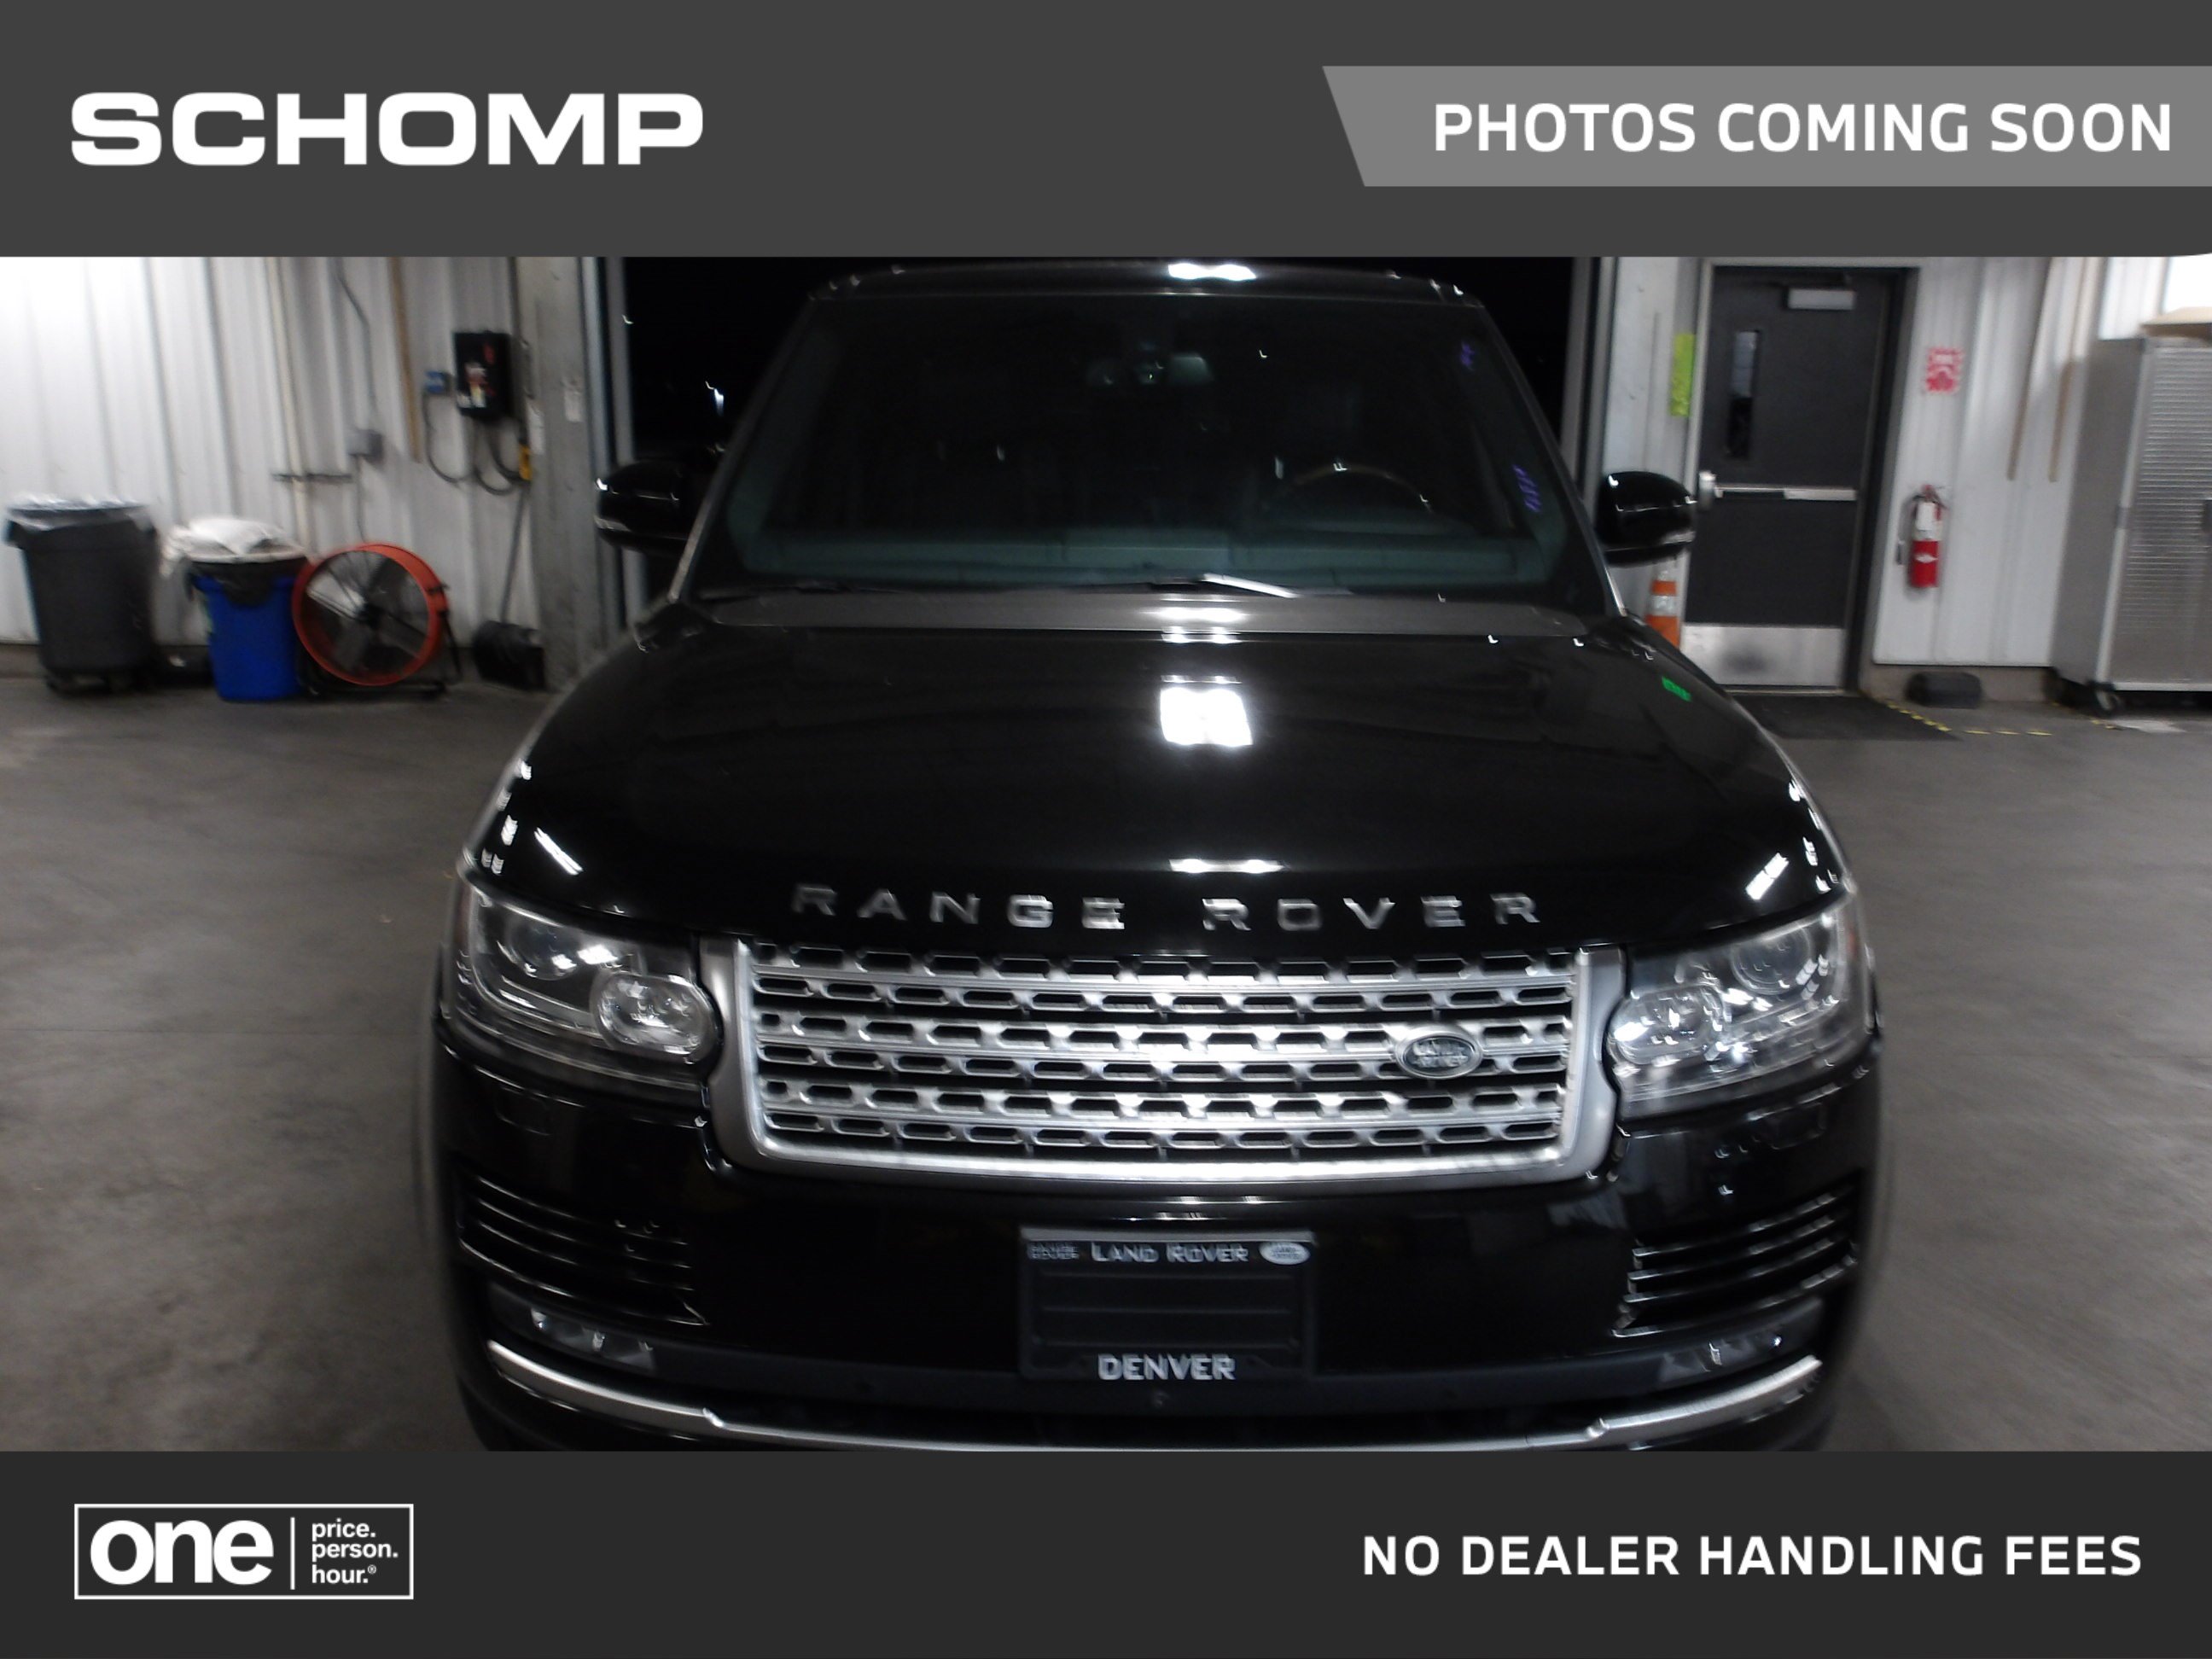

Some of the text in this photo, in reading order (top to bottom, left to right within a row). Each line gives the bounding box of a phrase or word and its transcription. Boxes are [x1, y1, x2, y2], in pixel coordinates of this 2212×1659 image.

[793, 884, 1540, 930] RANGE ROVER
[1091, 1243, 1159, 1262] LAND
[1167, 1243, 1249, 1262] ROVER
[1097, 1353, 1236, 1381] DENVER
